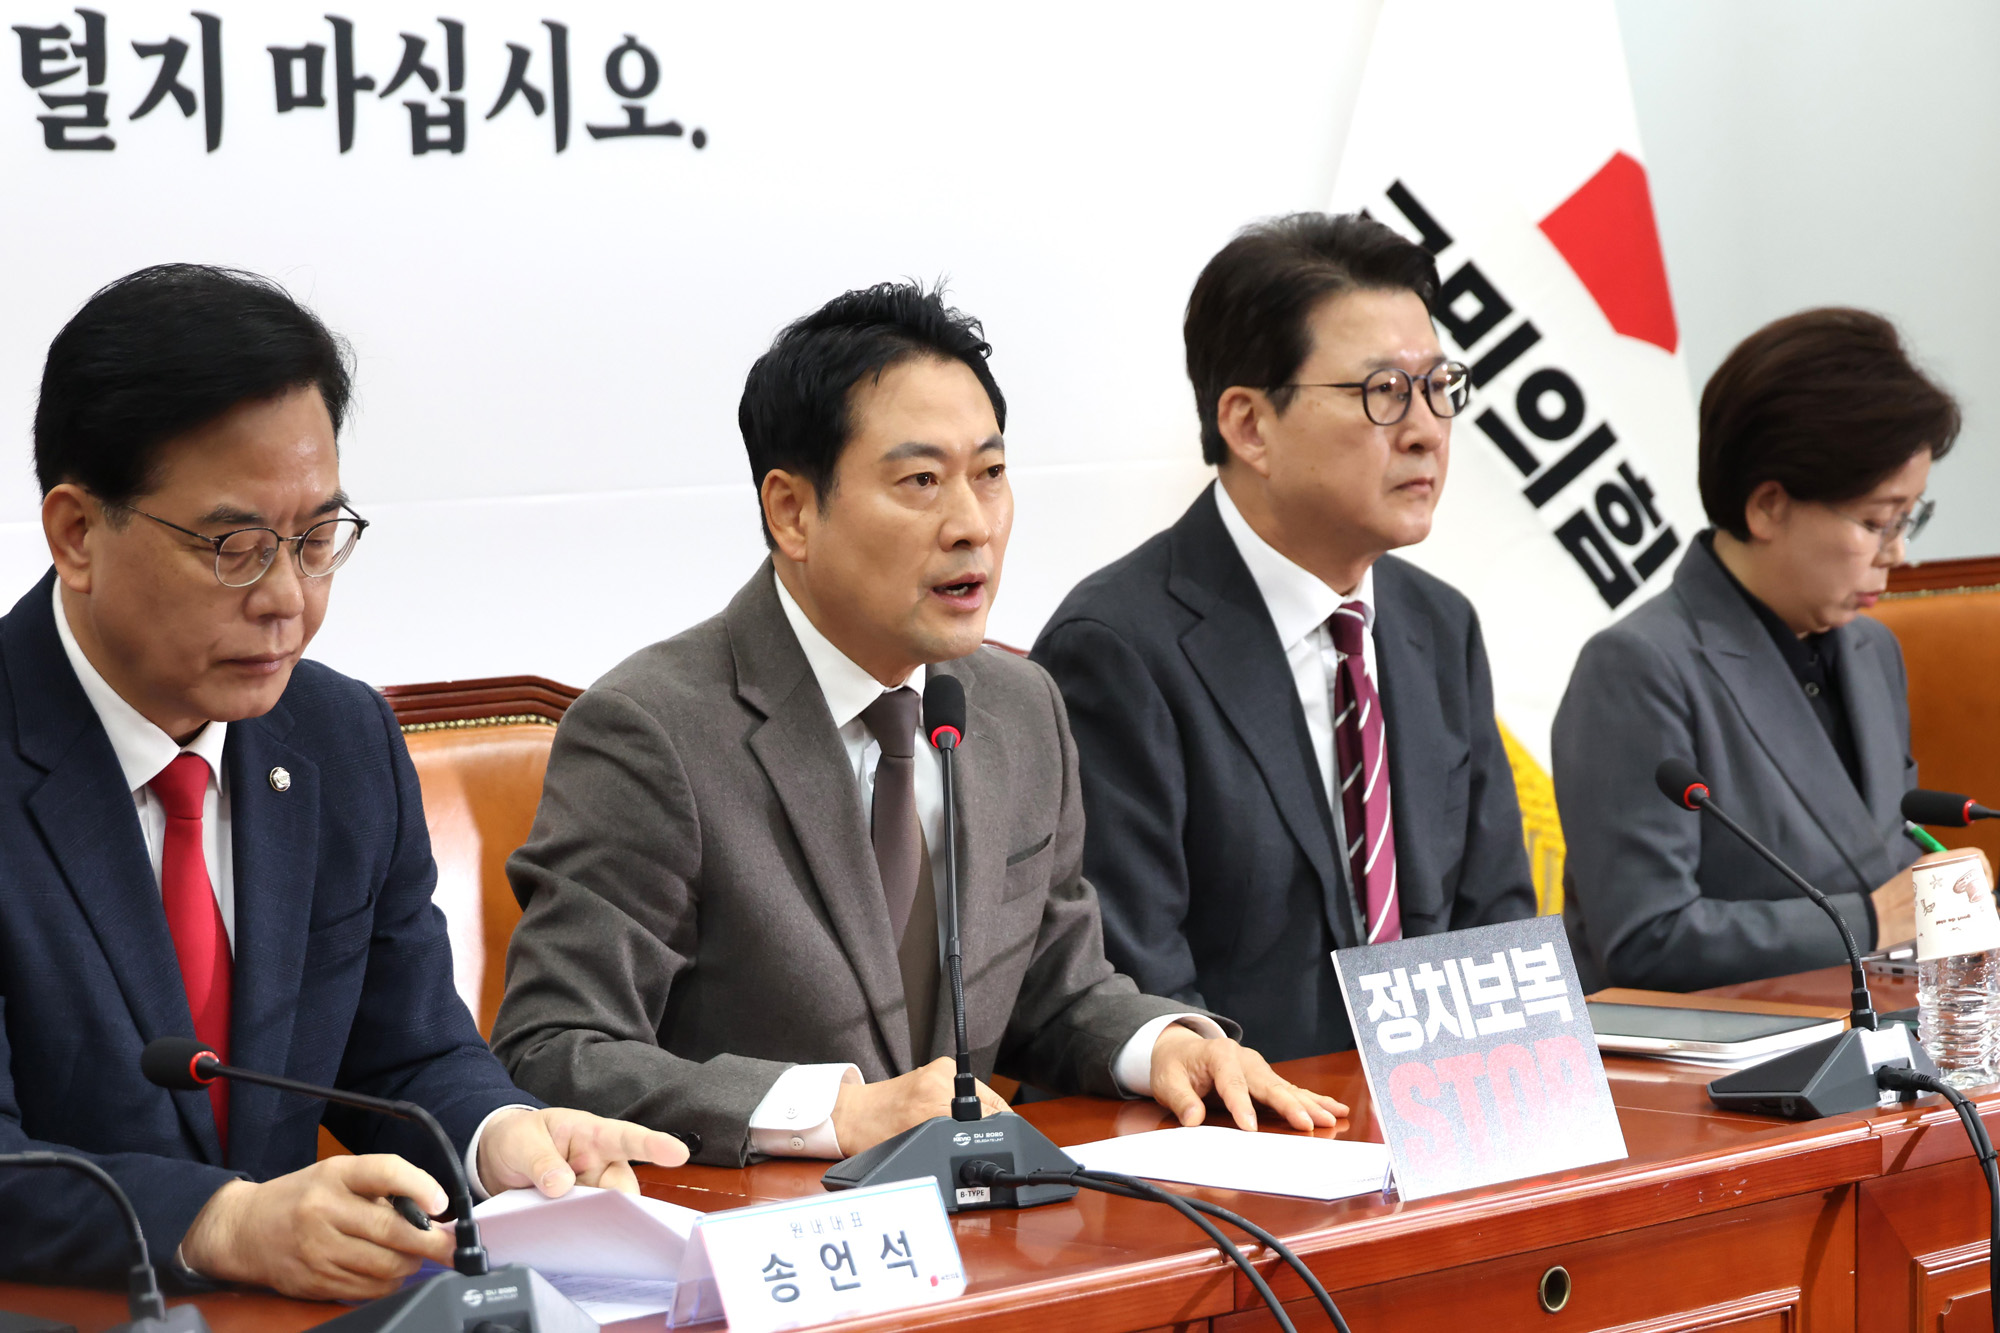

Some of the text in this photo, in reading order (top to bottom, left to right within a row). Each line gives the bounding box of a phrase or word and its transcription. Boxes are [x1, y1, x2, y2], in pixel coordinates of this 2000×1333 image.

[11, 7, 708, 155] 털지 마십시오.
[1358, 941, 1574, 1054] 정치보복
[1388, 1035, 1597, 1176] STOP
[960, 1189, 985, 1198] B-TYPE
[761, 1230, 919, 1303] 송언석
